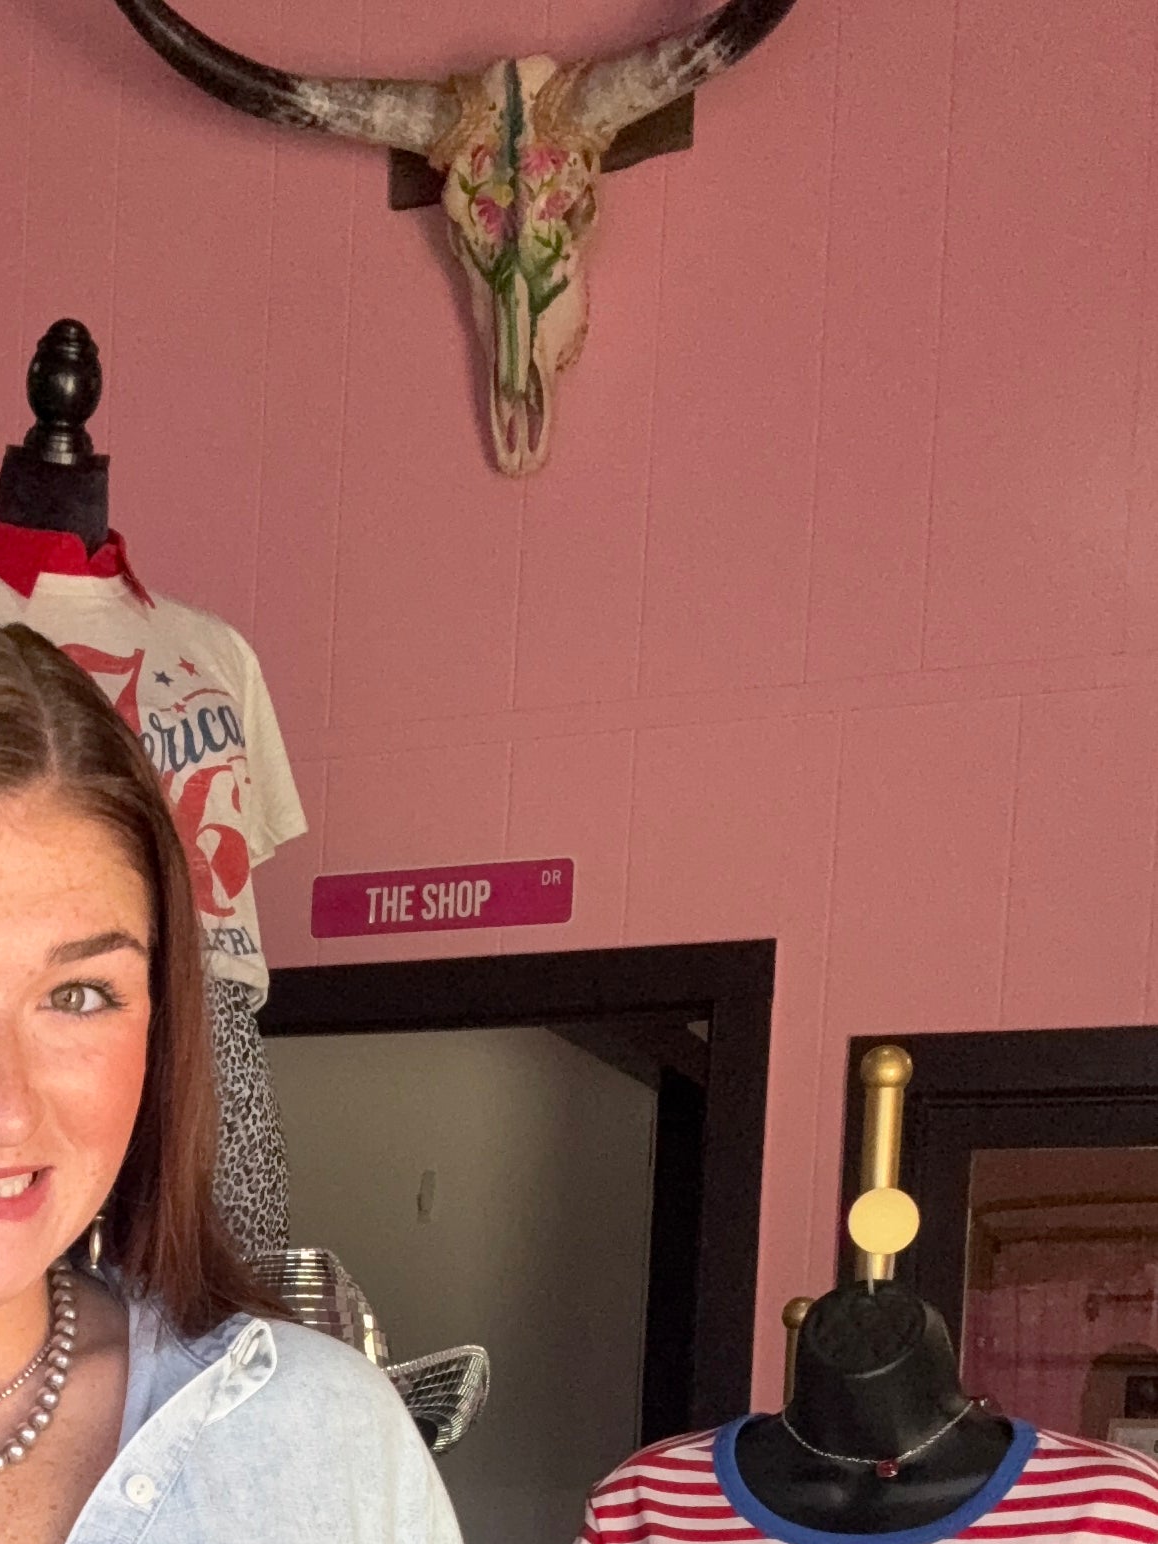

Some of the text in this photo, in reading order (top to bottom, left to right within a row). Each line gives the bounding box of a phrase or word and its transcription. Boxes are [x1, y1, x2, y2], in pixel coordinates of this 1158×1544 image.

[143, 704, 246, 775] erica
[365, 869, 562, 924] THE SHOP DR
